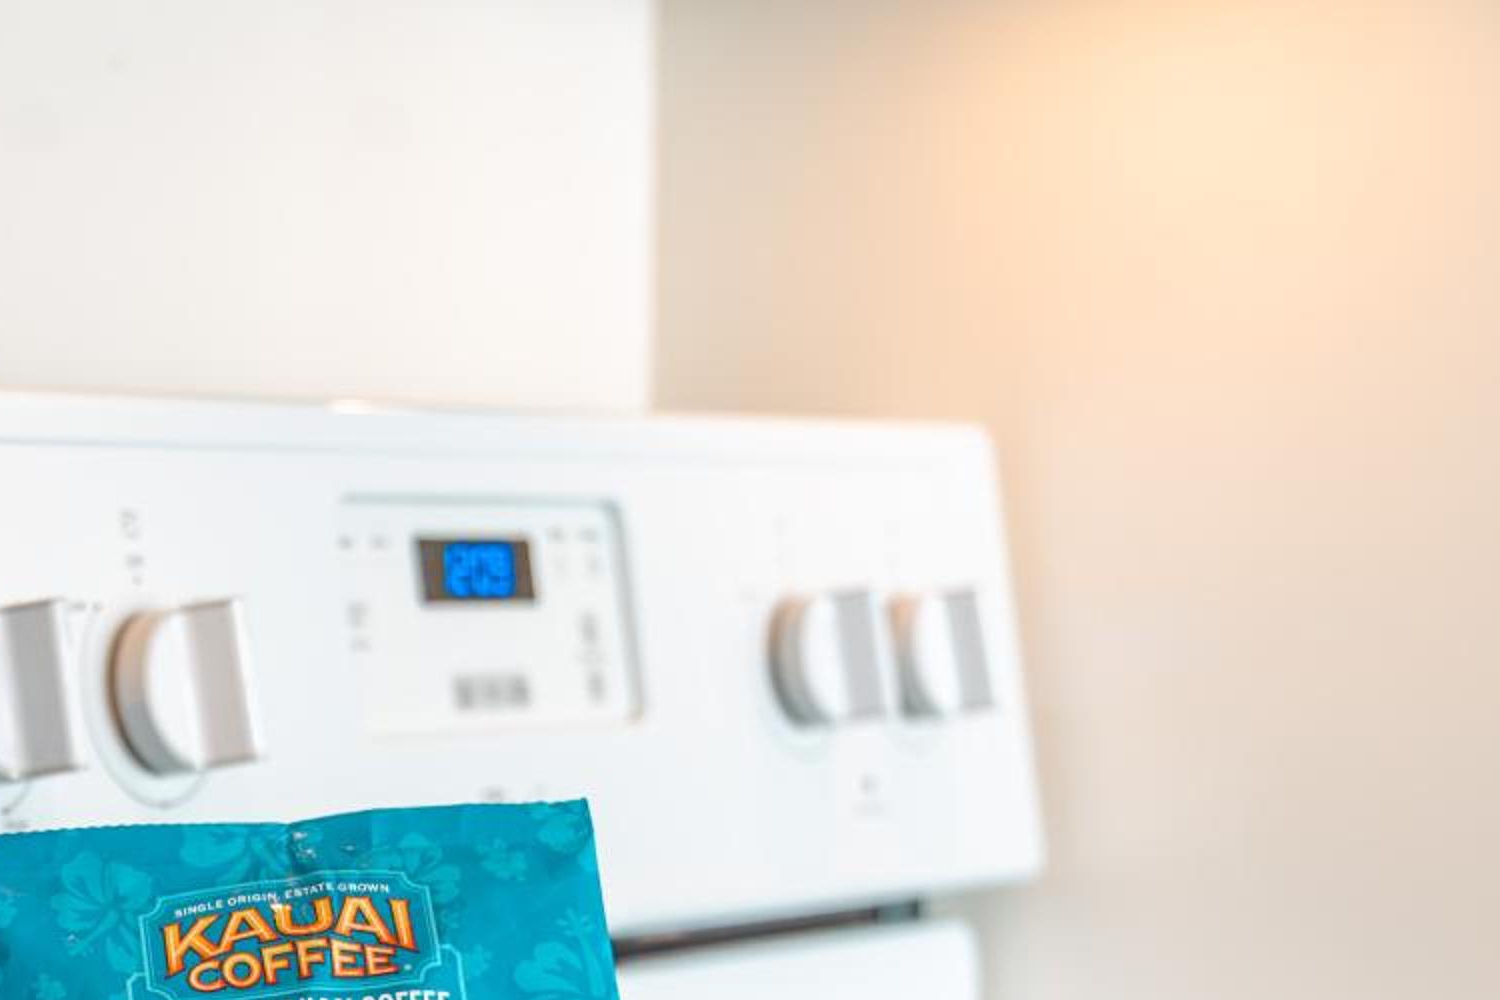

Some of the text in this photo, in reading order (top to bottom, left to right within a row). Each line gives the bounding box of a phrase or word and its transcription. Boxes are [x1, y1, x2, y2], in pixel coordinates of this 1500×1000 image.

[175, 898, 223, 919] SINGLE
[285, 882, 334, 899] ESTATE
[337, 882, 390, 894] GROWN
[162, 895, 419, 978] KAUAI
[188, 937, 399, 992] COFFEE
